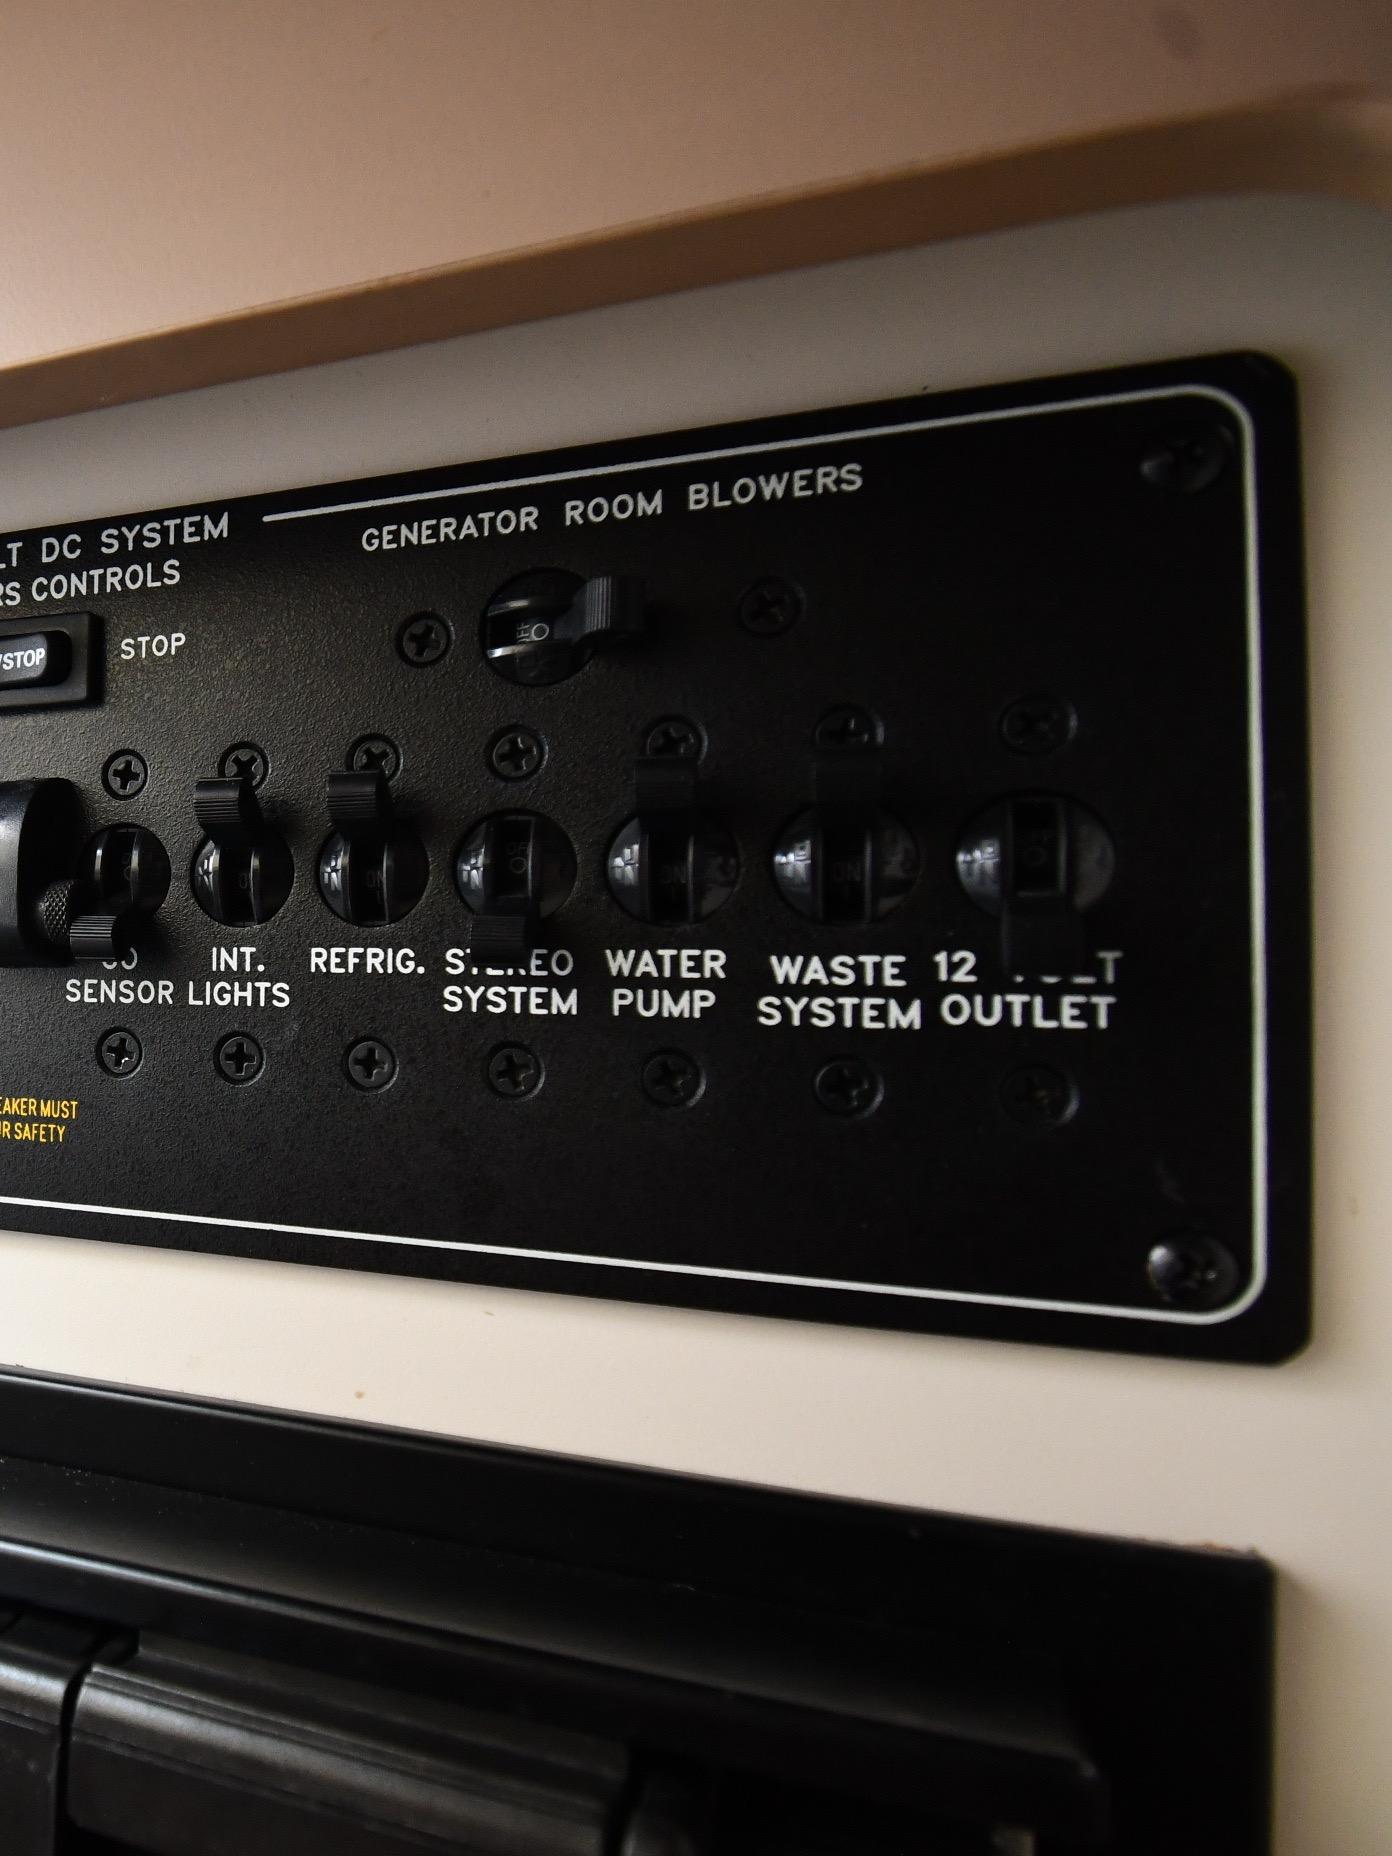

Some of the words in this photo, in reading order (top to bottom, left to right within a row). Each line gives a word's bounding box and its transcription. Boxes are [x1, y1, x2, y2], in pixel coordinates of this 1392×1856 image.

[360, 506, 540, 552] GENERATOR
[565, 490, 664, 527] ROOM
[687, 463, 864, 511] BLOWERS
[41, 533, 82, 563] DC
[100, 512, 229, 554] SYSTEM
[31, 559, 181, 601] CONTROLS
[120, 632, 186, 660] STOP
[212, 946, 265, 973] INT.
[310, 947, 426, 974] REFRIG.
[444, 947, 574, 976] SEO
[605, 949, 726, 979] WATER
[770, 954, 906, 987] WASTE
[933, 950, 978, 983] 12
[66, 979, 174, 1004] SENSOR
[188, 980, 291, 1008] LIGHTS
[443, 985, 578, 1016] SYSTEM
[612, 989, 716, 1019] PUMP
[757, 996, 922, 1031] SYSTEM
[940, 994, 1117, 1030] OUTLET
[40, 1099, 78, 1119] MUST
[14, 1121, 66, 1143] SAFETY
